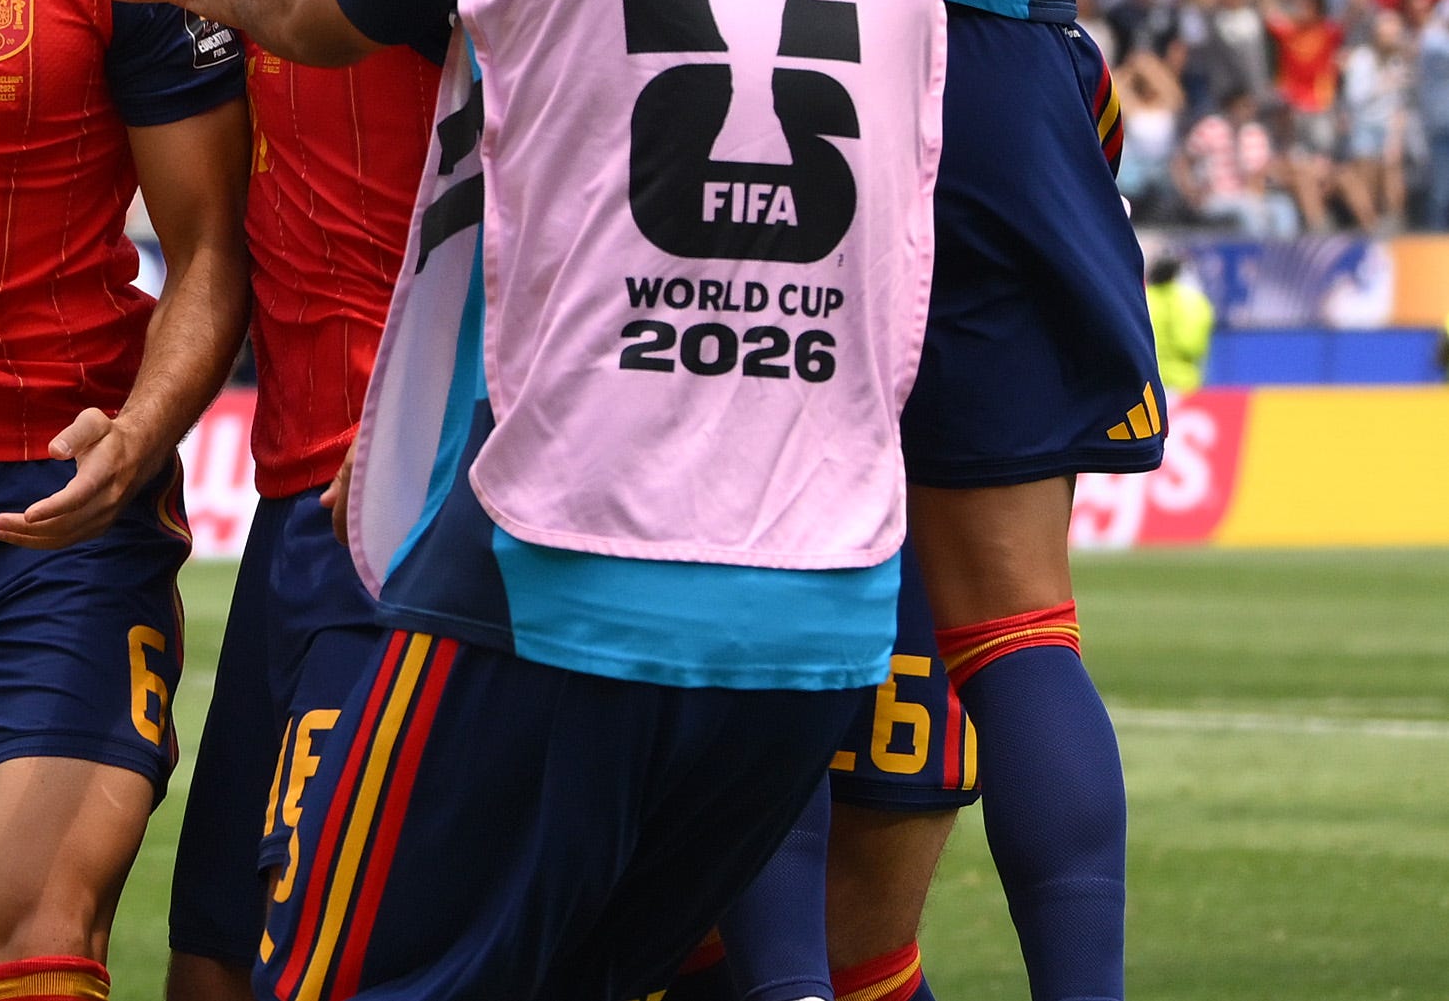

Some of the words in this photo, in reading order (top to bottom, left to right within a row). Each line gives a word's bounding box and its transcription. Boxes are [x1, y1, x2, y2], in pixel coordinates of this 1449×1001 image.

[213, 47, 226, 58] FIFA
[702, 182, 798, 226] FIFA
[626, 277, 769, 312] WORLD
[778, 283, 844, 318] CUP
[619, 319, 837, 383] 2026
[127, 625, 168, 746] 6
[829, 654, 932, 774] 6
